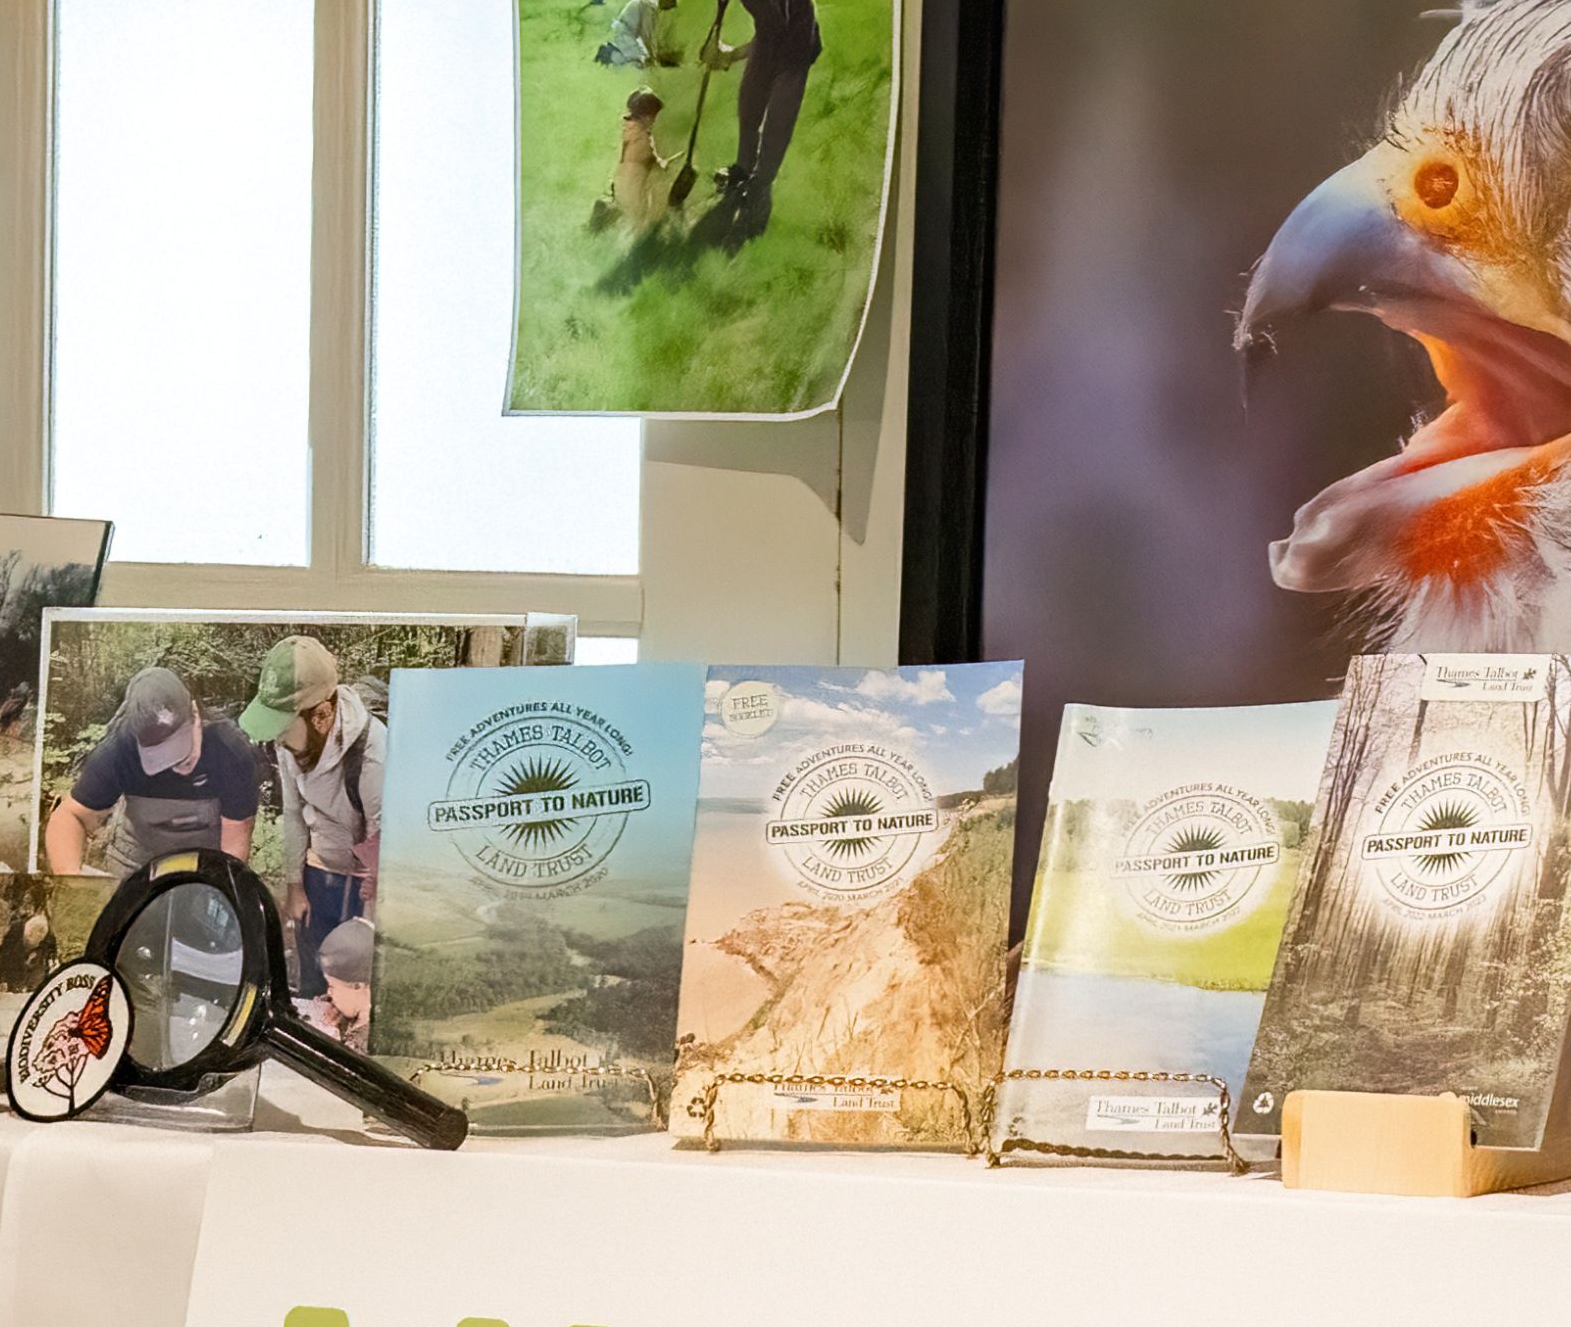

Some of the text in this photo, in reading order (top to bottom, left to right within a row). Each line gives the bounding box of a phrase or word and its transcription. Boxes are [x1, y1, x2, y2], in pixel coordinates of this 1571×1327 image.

[469, 725, 612, 772] THAMES TALBOT
[435, 786, 643, 823] PASSPORT TO NATURE
[772, 814, 933, 837] PASSPORT TO NATURE
[1367, 829, 1527, 853] PASSPORT TO NATURE
[476, 843, 593, 878] LAND TRUST
[18, 974, 96, 1085] BIODIVERSITY BOSS
